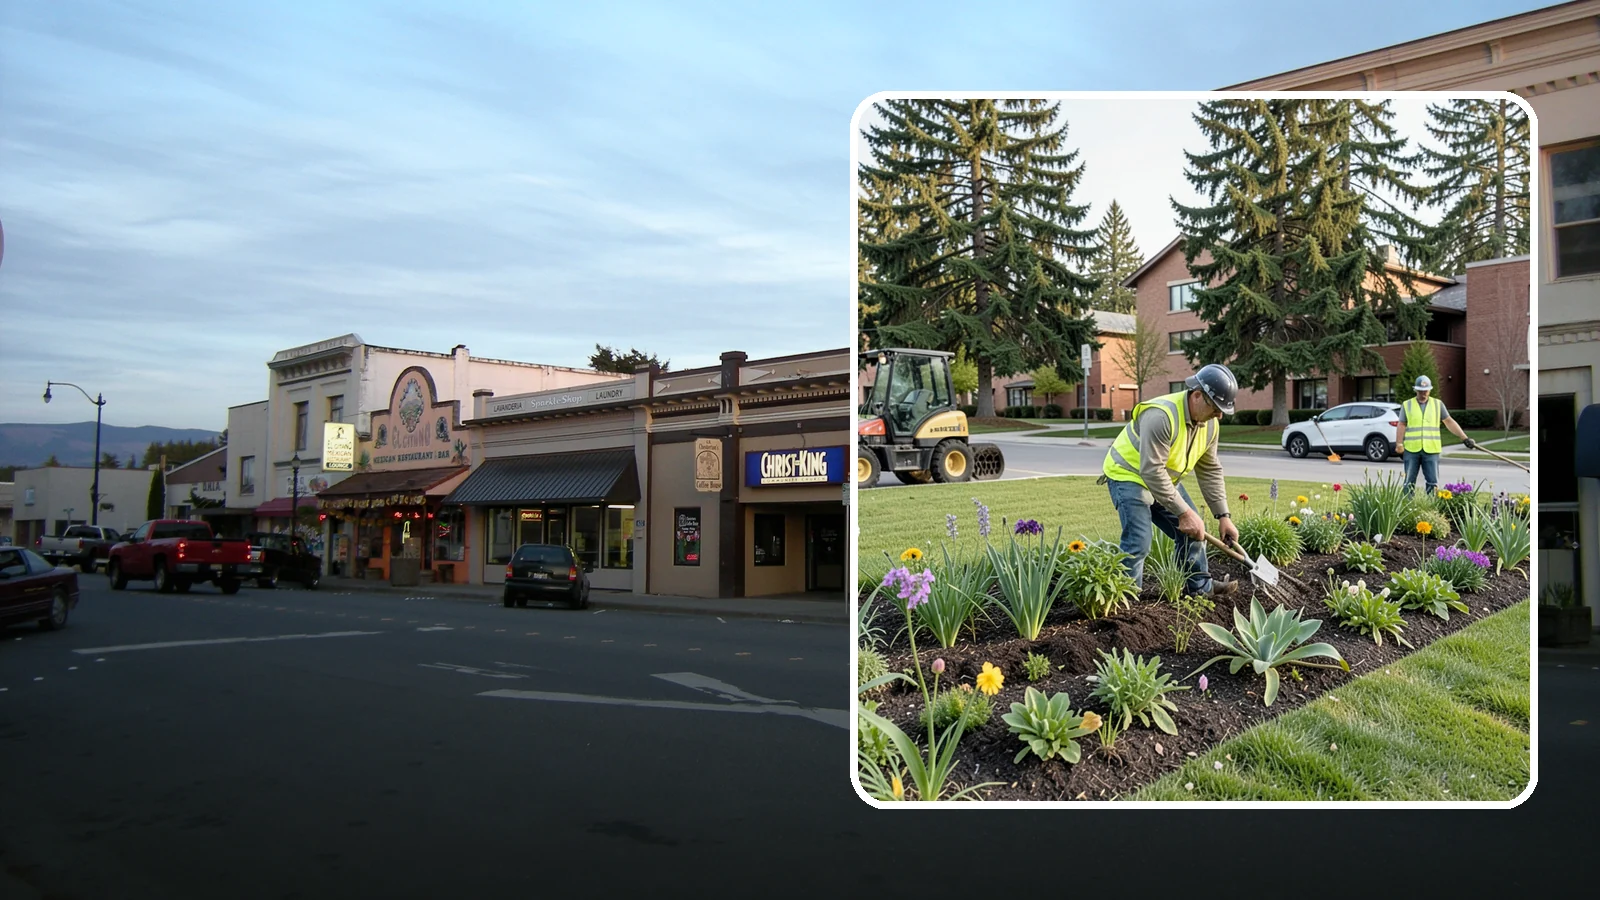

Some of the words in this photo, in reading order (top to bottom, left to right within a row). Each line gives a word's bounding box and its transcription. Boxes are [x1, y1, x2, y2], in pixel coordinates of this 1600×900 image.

[562, 394, 583, 406] Shop
[595, 388, 623, 400] LAUNDRY
[493, 402, 522, 413] LAVANDERIA
[373, 455, 396, 464] MEXICAN
[397, 451, 433, 462] RESTAURANT
[437, 450, 450, 458] BAR
[761, 452, 797, 477] CHRIST
[799, 450, 827, 476] KING
